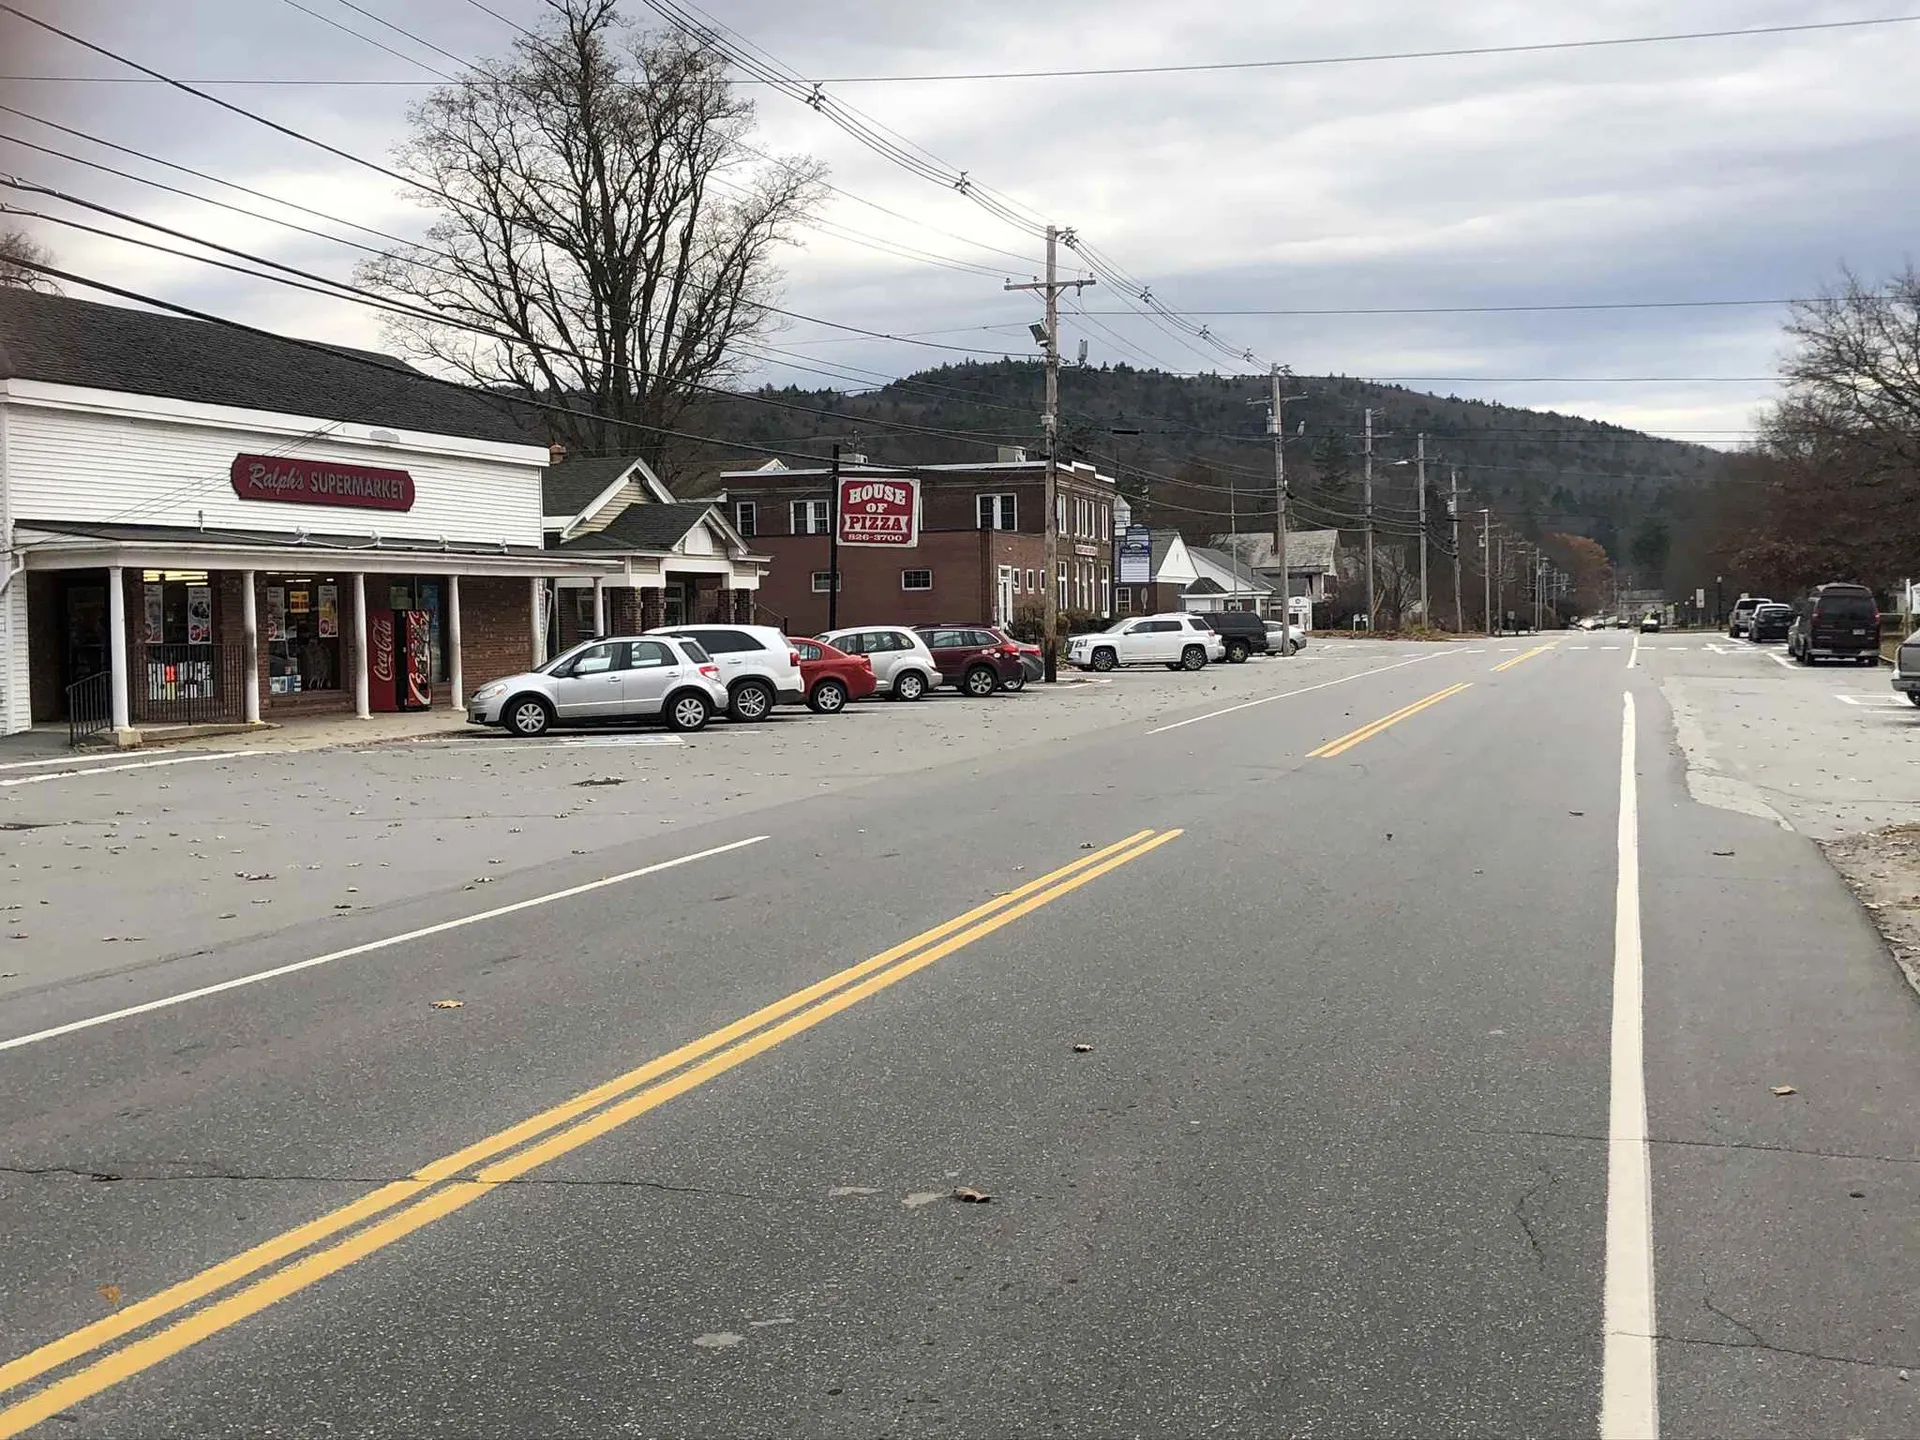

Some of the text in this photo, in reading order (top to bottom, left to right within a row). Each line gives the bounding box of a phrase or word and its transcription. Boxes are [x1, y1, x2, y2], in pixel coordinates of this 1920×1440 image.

[249, 463, 405, 500] Ralph's SUPERMARKET
[848, 484, 906, 505] HOUSE
[865, 503, 888, 513] OF
[848, 515, 903, 531] PIZZA
